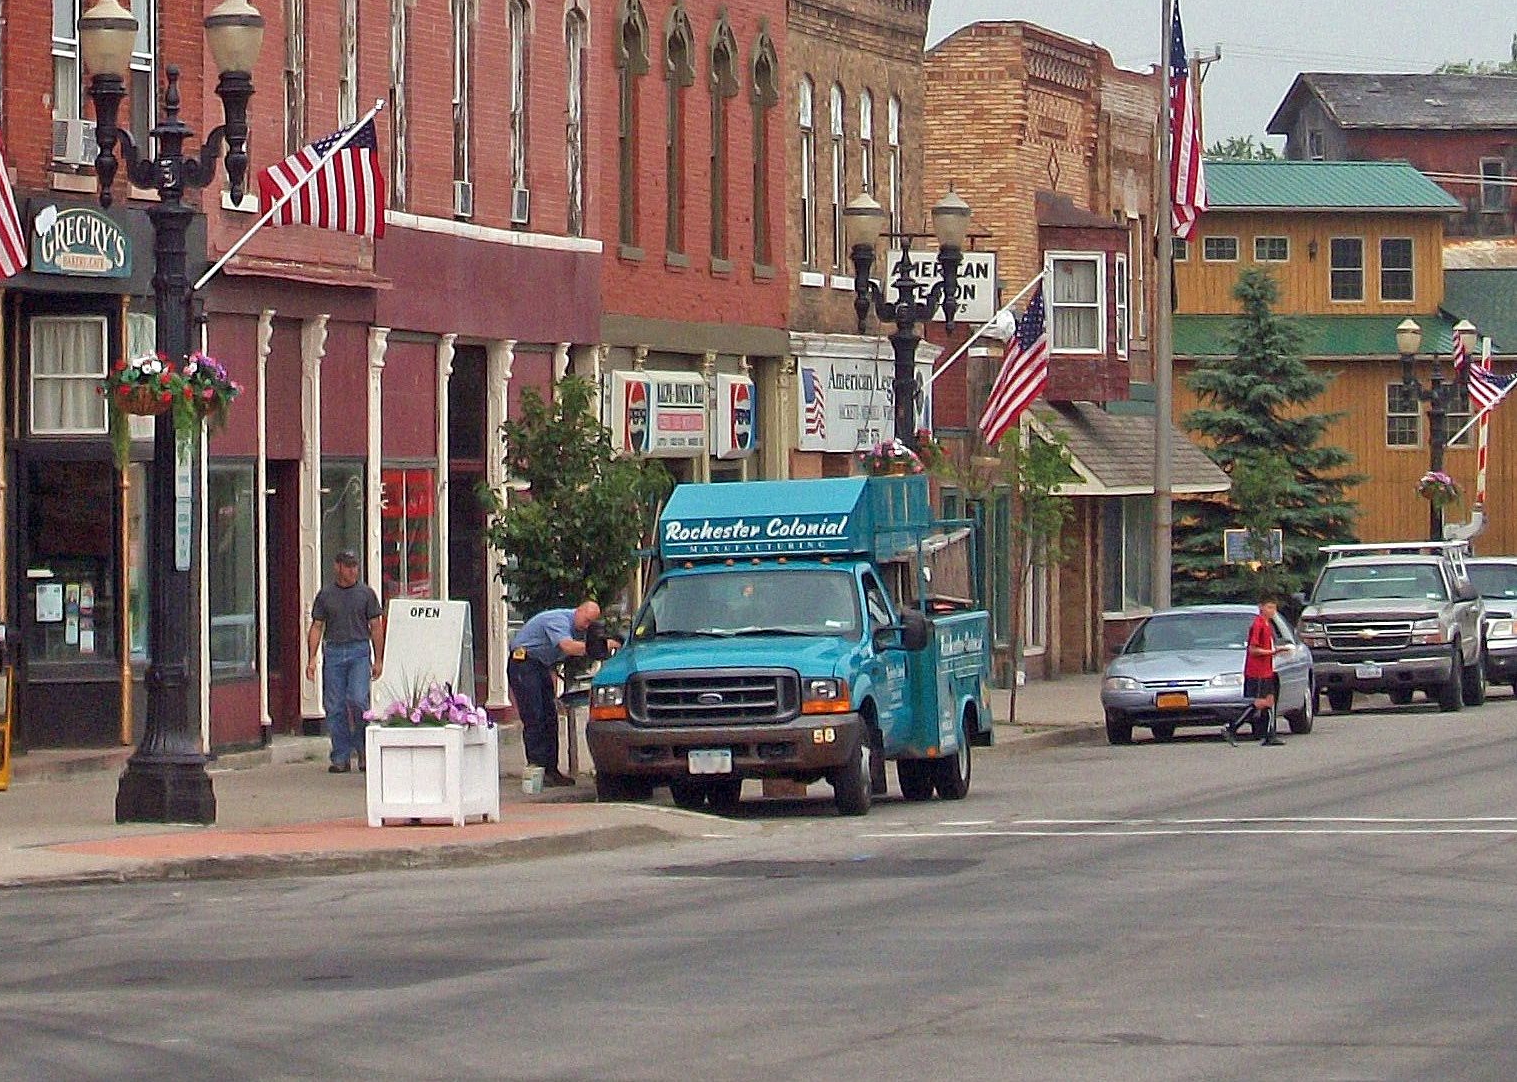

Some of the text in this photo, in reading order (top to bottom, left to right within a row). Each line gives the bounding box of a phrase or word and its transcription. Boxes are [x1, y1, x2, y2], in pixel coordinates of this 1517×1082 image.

[891, 261, 989, 279] AMERAN
[828, 364, 873, 390] American
[665, 515, 849, 542] Rochester Colonial
[689, 540, 826, 553] MANUFACTURING
[410, 606, 440, 618] OPEN
